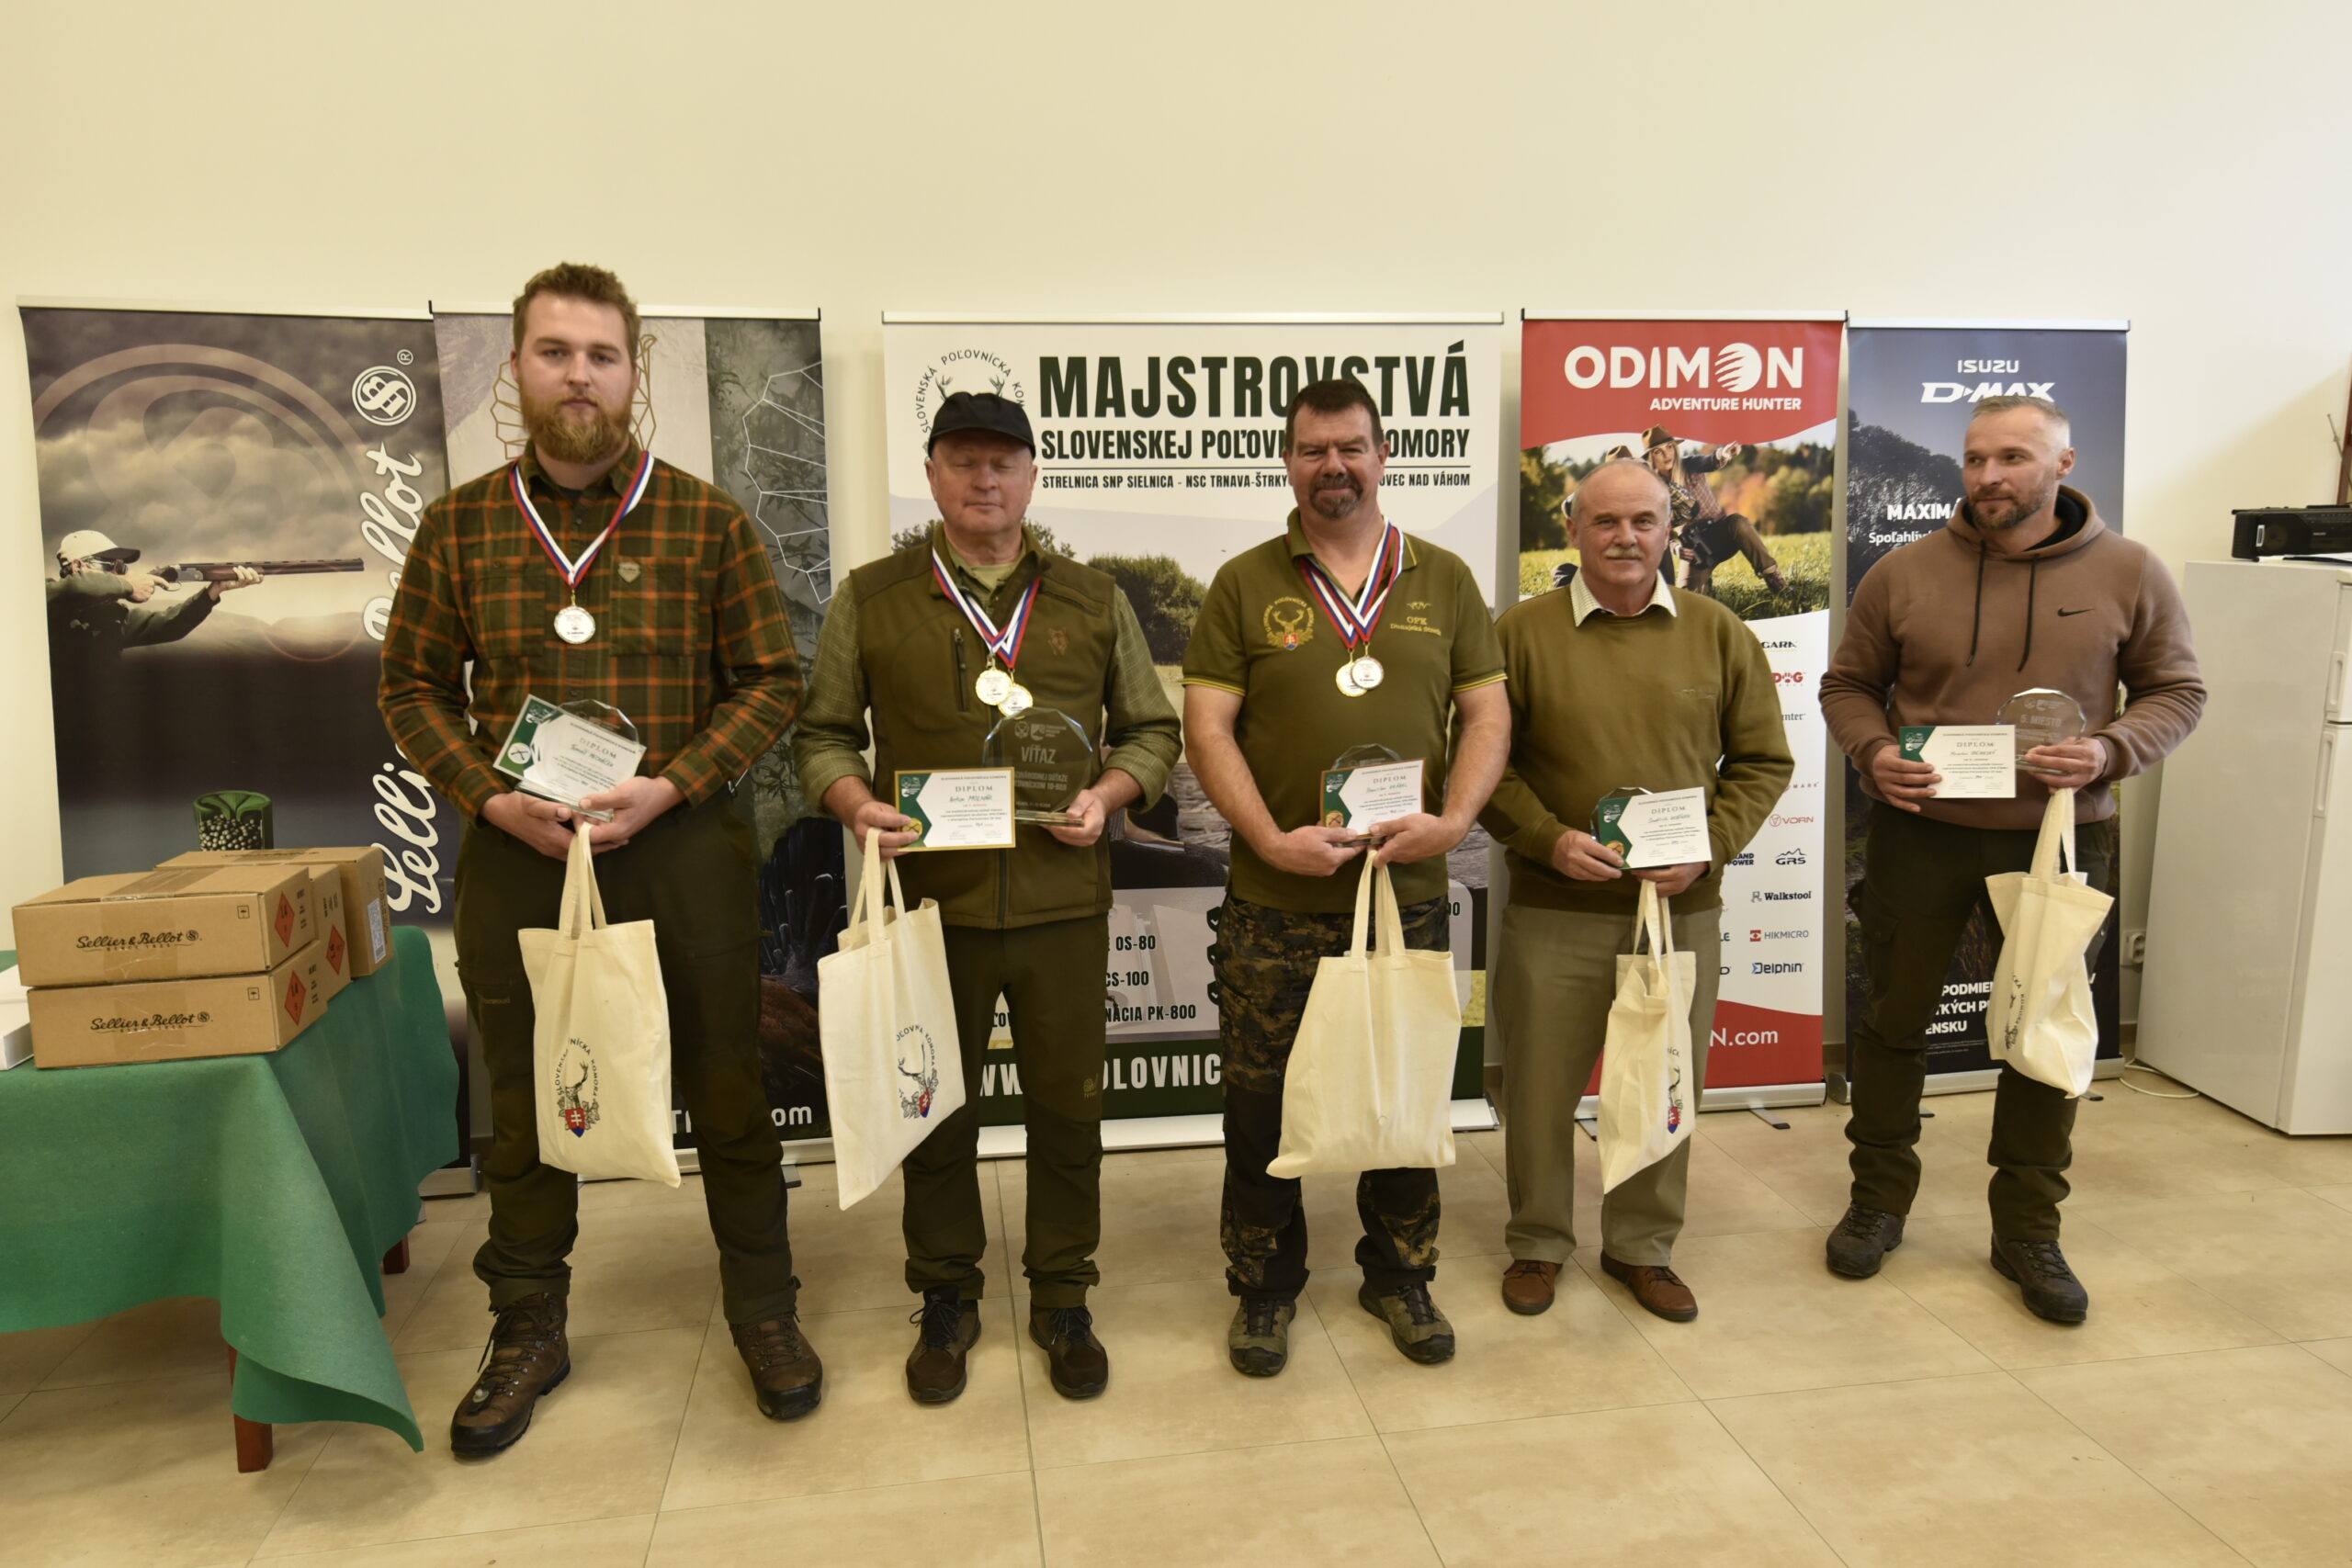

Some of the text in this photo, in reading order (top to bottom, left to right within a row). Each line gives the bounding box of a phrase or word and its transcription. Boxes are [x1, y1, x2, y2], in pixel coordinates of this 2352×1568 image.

[941, 349, 1012, 377] POĽOVNÍCKA
[1565, 343, 1804, 392] ODIMON
[1957, 359, 2020, 374] ISUZU
[916, 365, 937, 434] SLOVENSKÁ
[1650, 397, 1802, 411] ADVENTURE HUNTER
[1041, 430, 1193, 459] SLOVENSKEJ
[1382, 428, 1470, 458] OMORY
[1042, 475, 1099, 489] STRELNICA
[1102, 475, 1124, 488] SNP
[1126, 474, 1174, 488] SIELNICA
[1185, 474, 1206, 488] NSC
[1409, 473, 1430, 486] NAD
[1433, 470, 1470, 486] VÁHOM
[1886, 497, 1962, 521] MAXIM
[1868, 530, 1933, 546] Spoľahliv
[1781, 713, 1804, 721] nter
[579, 737, 616, 759] DIPLOM
[1021, 743, 1057, 764] VÍŤAZ
[1373, 774, 1407, 784] DIPLOM
[1651, 806, 1686, 815] DIPLOM
[1781, 816, 1815, 824] VORN
[372, 743, 443, 915] Selli
[1775, 856, 1806, 865] GRS
[1763, 890, 1812, 901] Walkstool
[76, 931, 184, 949] Sellier & Bellot
[1115, 934, 1156, 951] OS-80
[1764, 930, 1810, 940] HIKMICRO
[1751, 962, 1803, 975] Delphin
[1148, 1004, 1196, 1021] PK-800
[1935, 998, 1976, 1016] KÝCH
[90, 1018, 139, 1031] Sellier
[141, 1018, 149, 1027] &
[150, 1013, 195, 1026] Bellot
